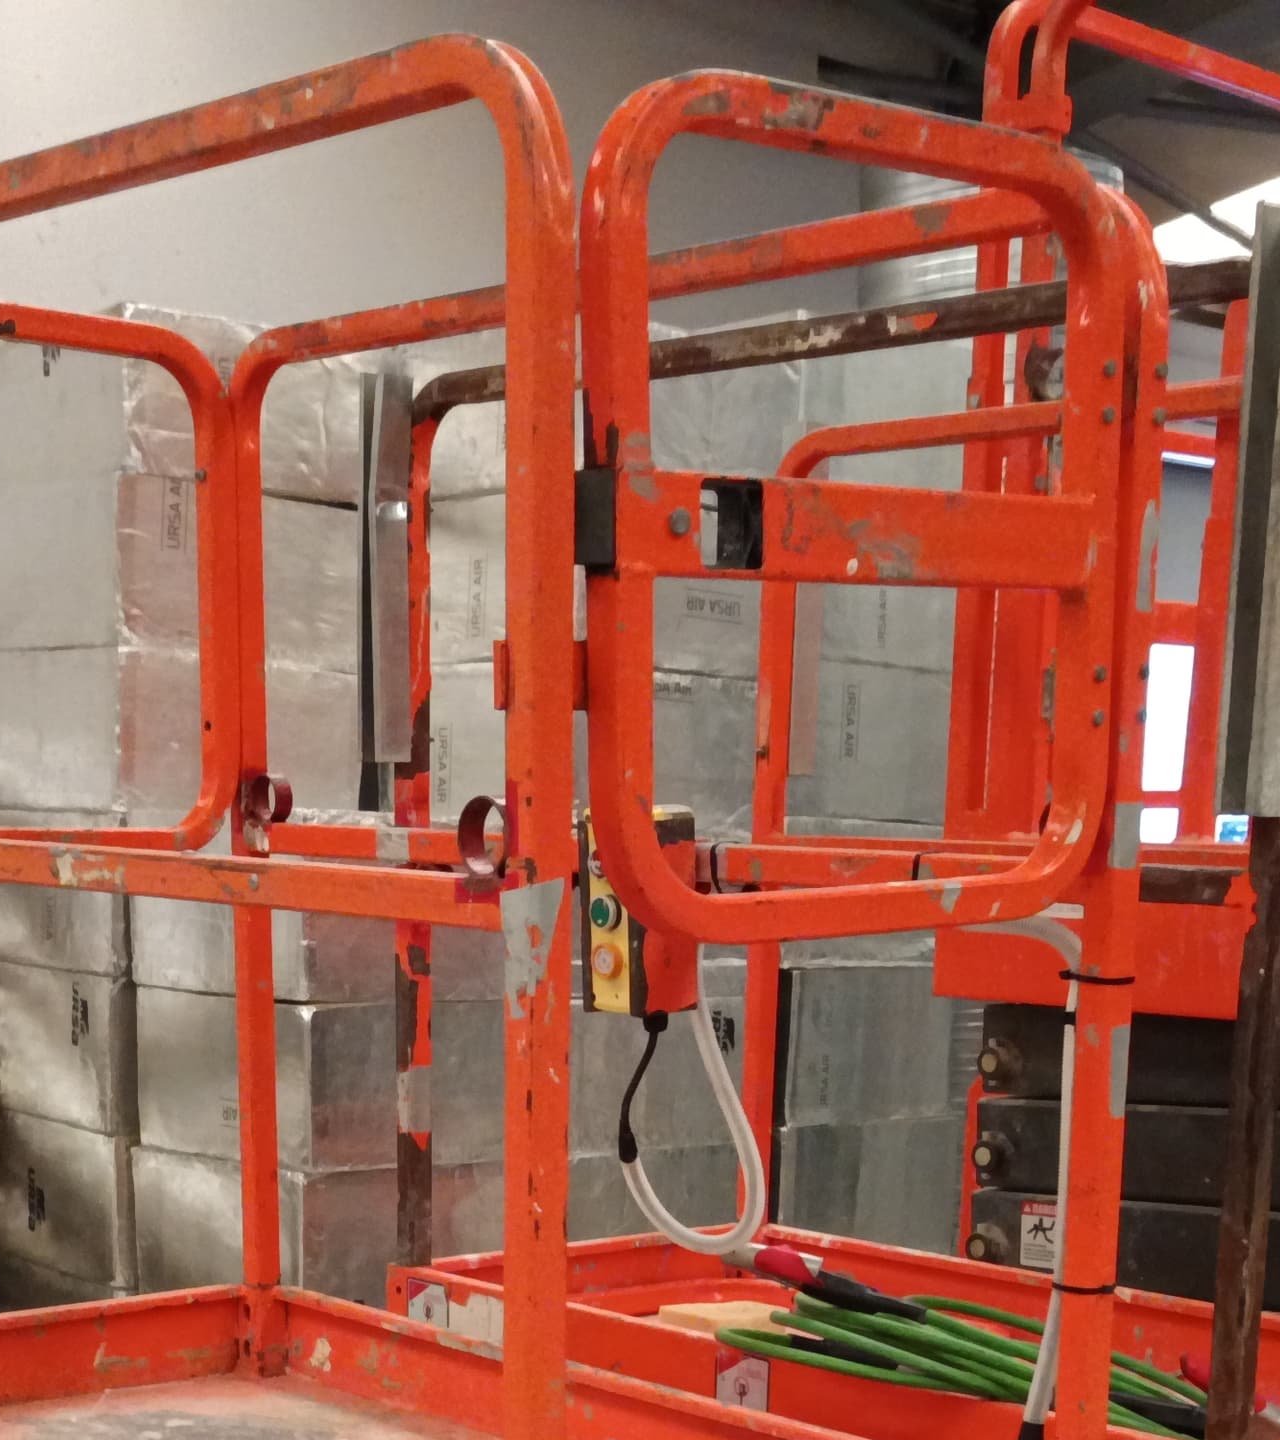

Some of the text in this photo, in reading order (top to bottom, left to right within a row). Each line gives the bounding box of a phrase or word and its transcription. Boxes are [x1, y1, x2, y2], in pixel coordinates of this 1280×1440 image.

[438, 727, 449, 772] URSA
[844, 684, 858, 759] URSA AIR
